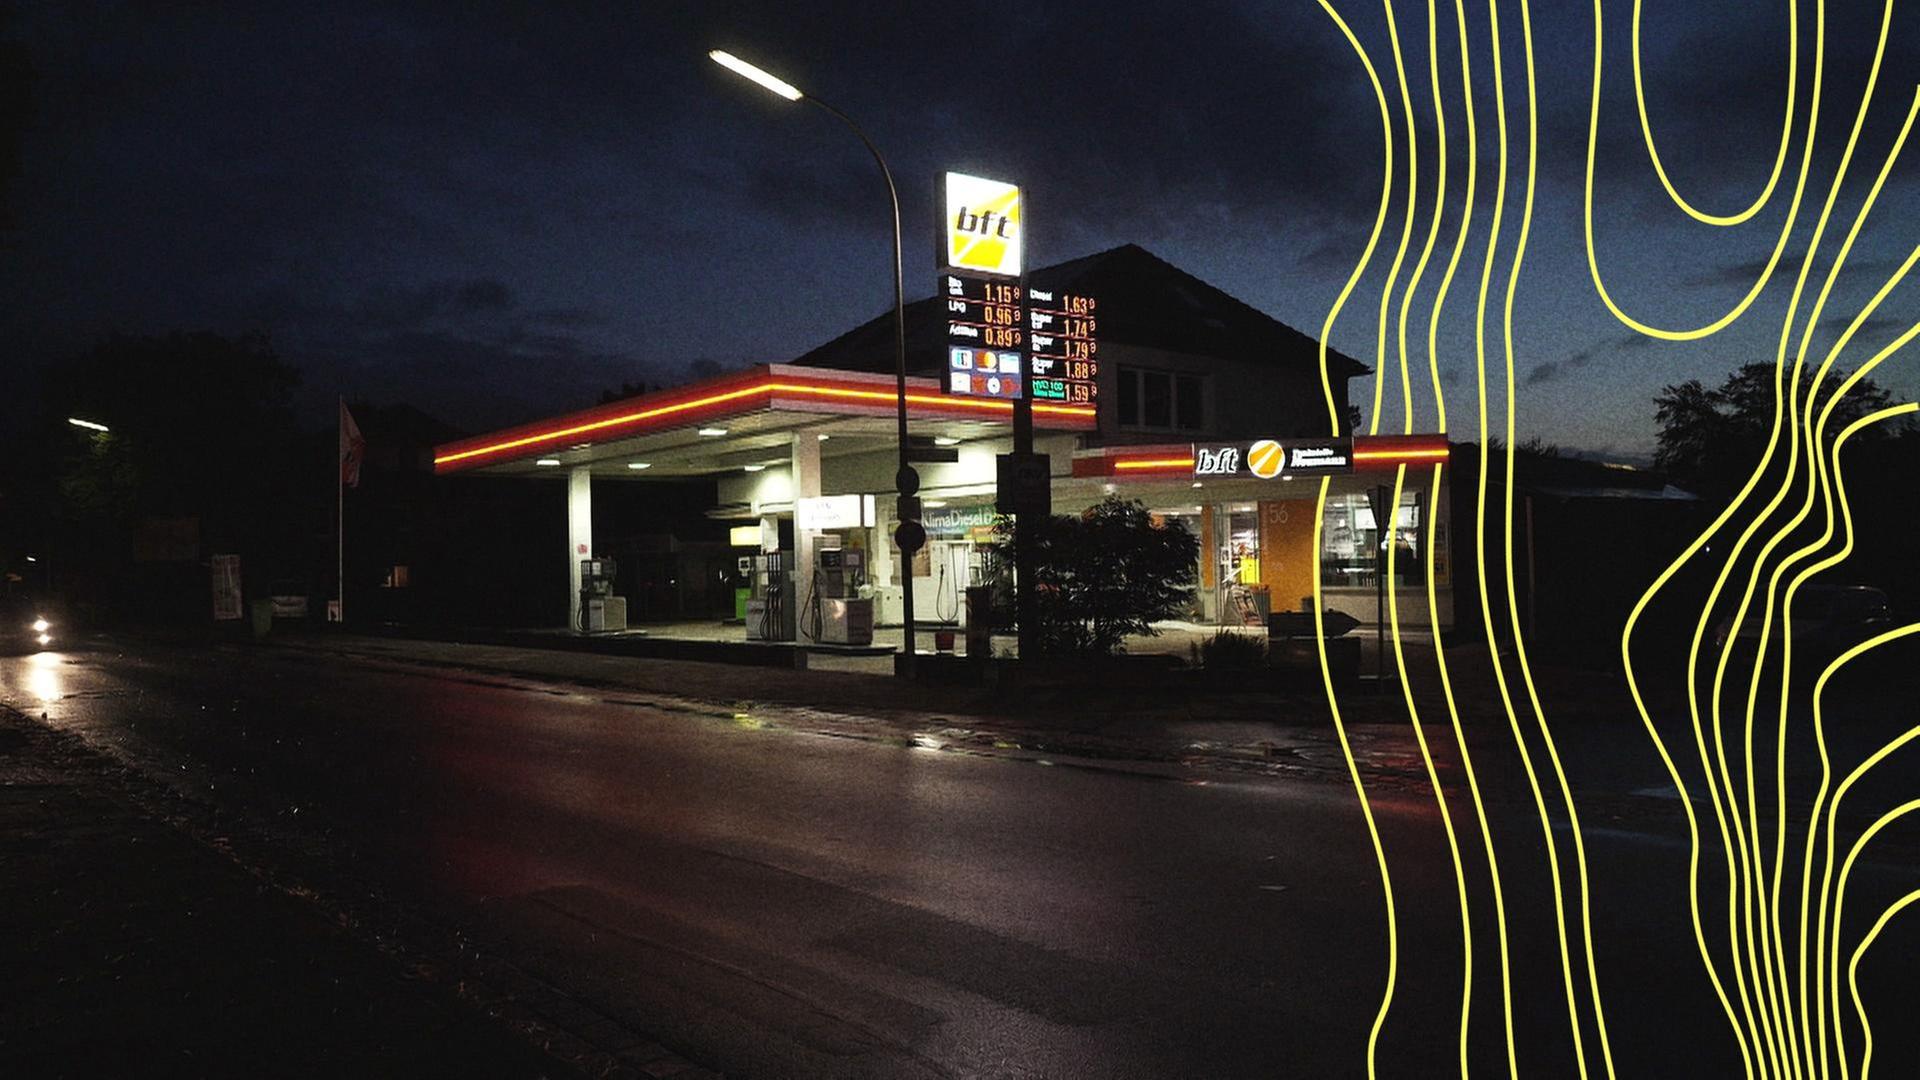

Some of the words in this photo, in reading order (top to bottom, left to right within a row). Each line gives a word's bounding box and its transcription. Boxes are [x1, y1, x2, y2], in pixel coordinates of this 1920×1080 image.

[957, 206, 1011, 239] bft
[1196, 448, 1238, 474] bft
[1268, 503, 1289, 524] 56
